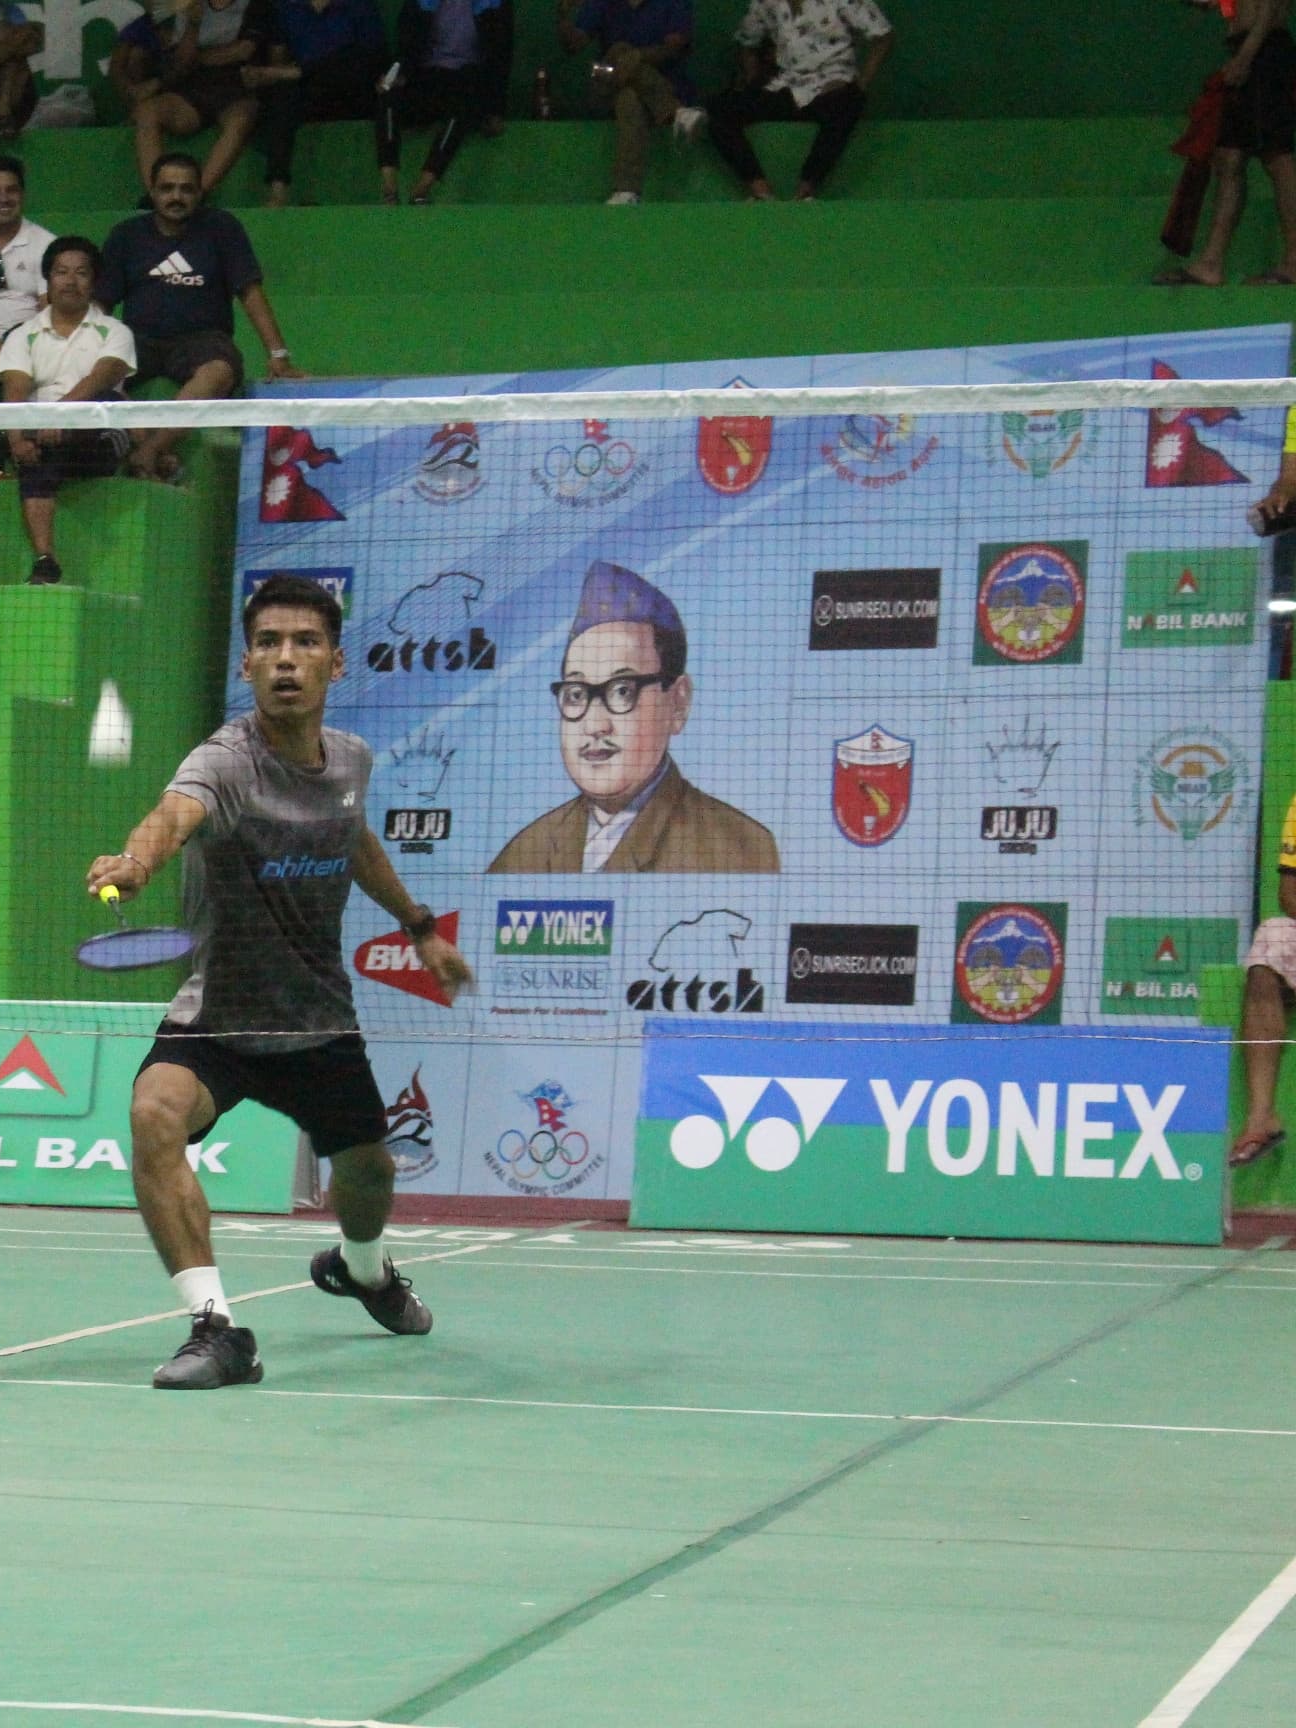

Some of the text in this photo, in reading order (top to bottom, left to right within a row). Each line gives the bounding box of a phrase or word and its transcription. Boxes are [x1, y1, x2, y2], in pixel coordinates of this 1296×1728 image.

[835, 600, 938, 619] SUNRISECLICK.COM
[1127, 611, 1248, 630] NABIL BANK
[542, 911, 606, 945] YONEX
[364, 945, 425, 971] BW
[812, 955, 917, 974] SUNRISECLICK.COM
[521, 968, 604, 990] SUNRISE
[1106, 981, 1201, 999] NABIL BA
[869, 1079, 1188, 1181] YONEX
[35, 1137, 231, 1174] BAK
[484, 1151, 506, 1181] NEPAL
[551, 1153, 604, 1195] COMMITTEE
